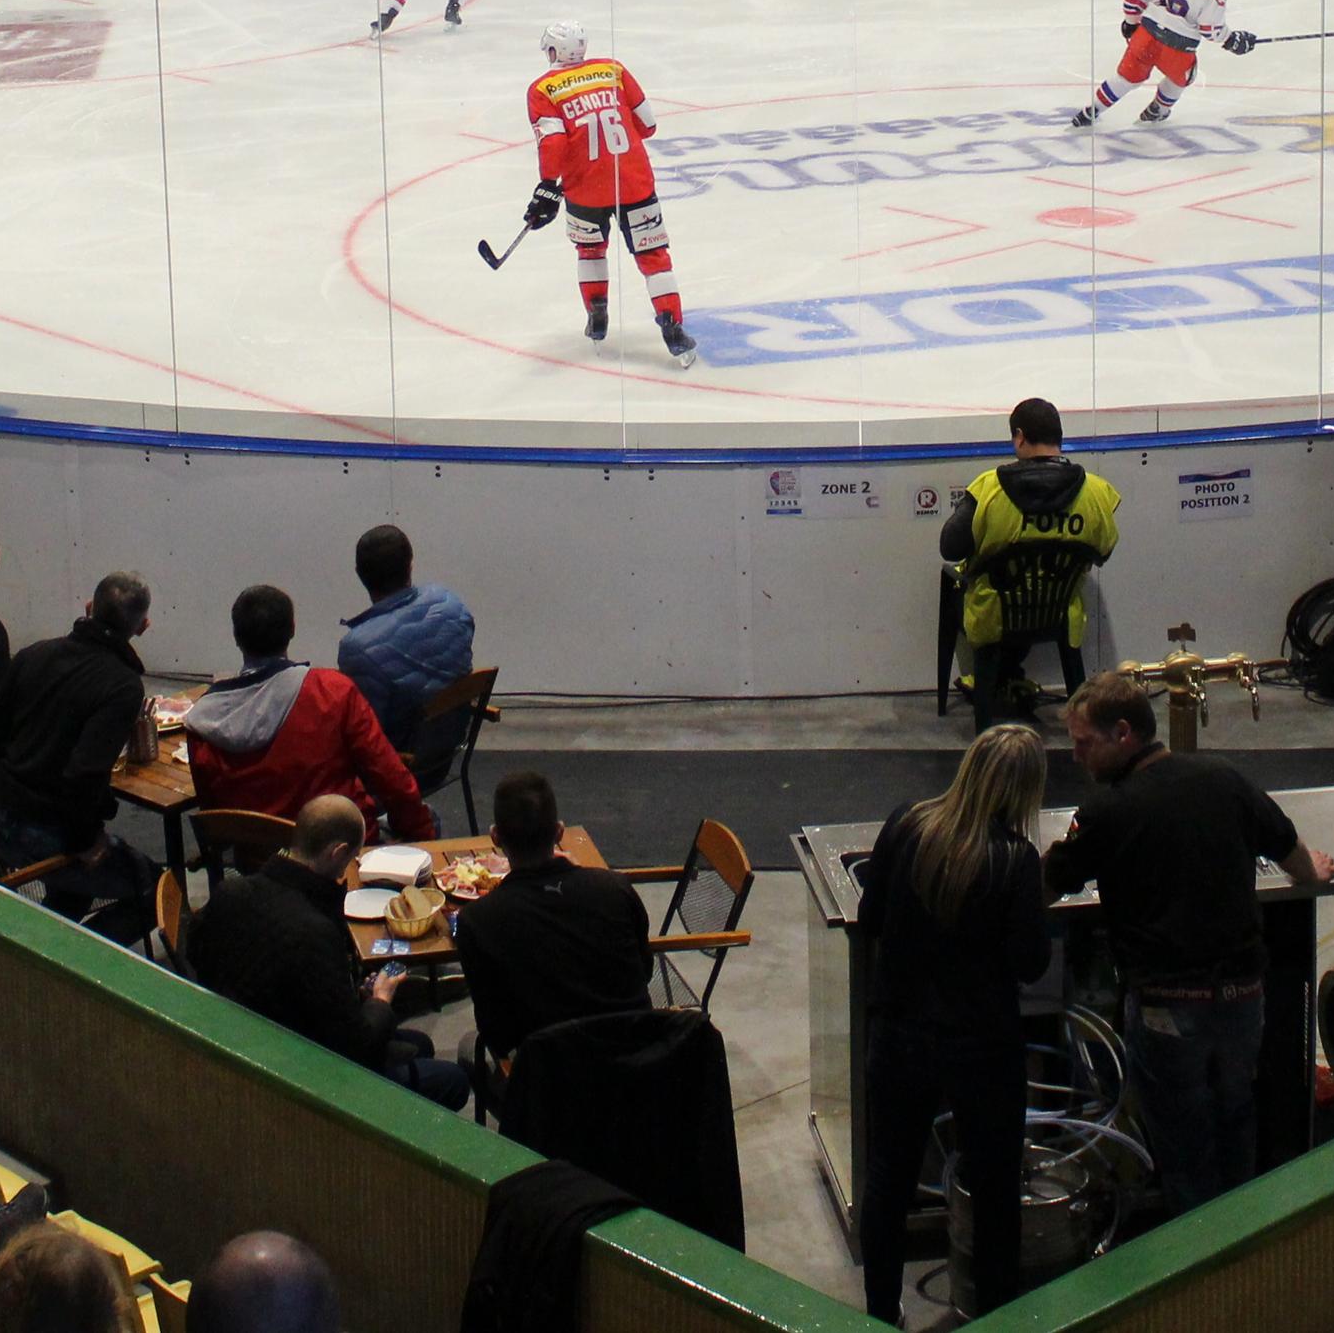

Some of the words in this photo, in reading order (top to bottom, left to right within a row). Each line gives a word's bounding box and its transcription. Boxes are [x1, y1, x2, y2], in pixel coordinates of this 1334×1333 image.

[575, 108, 631, 161] 76
[821, 483, 857, 495] ZONE
[861, 481, 871, 493] 2
[1195, 482, 1235, 495] PHOTO
[1181, 495, 1240, 509] POSITION
[1242, 494, 1250, 505] 2
[1022, 512, 1085, 537] FOTO
